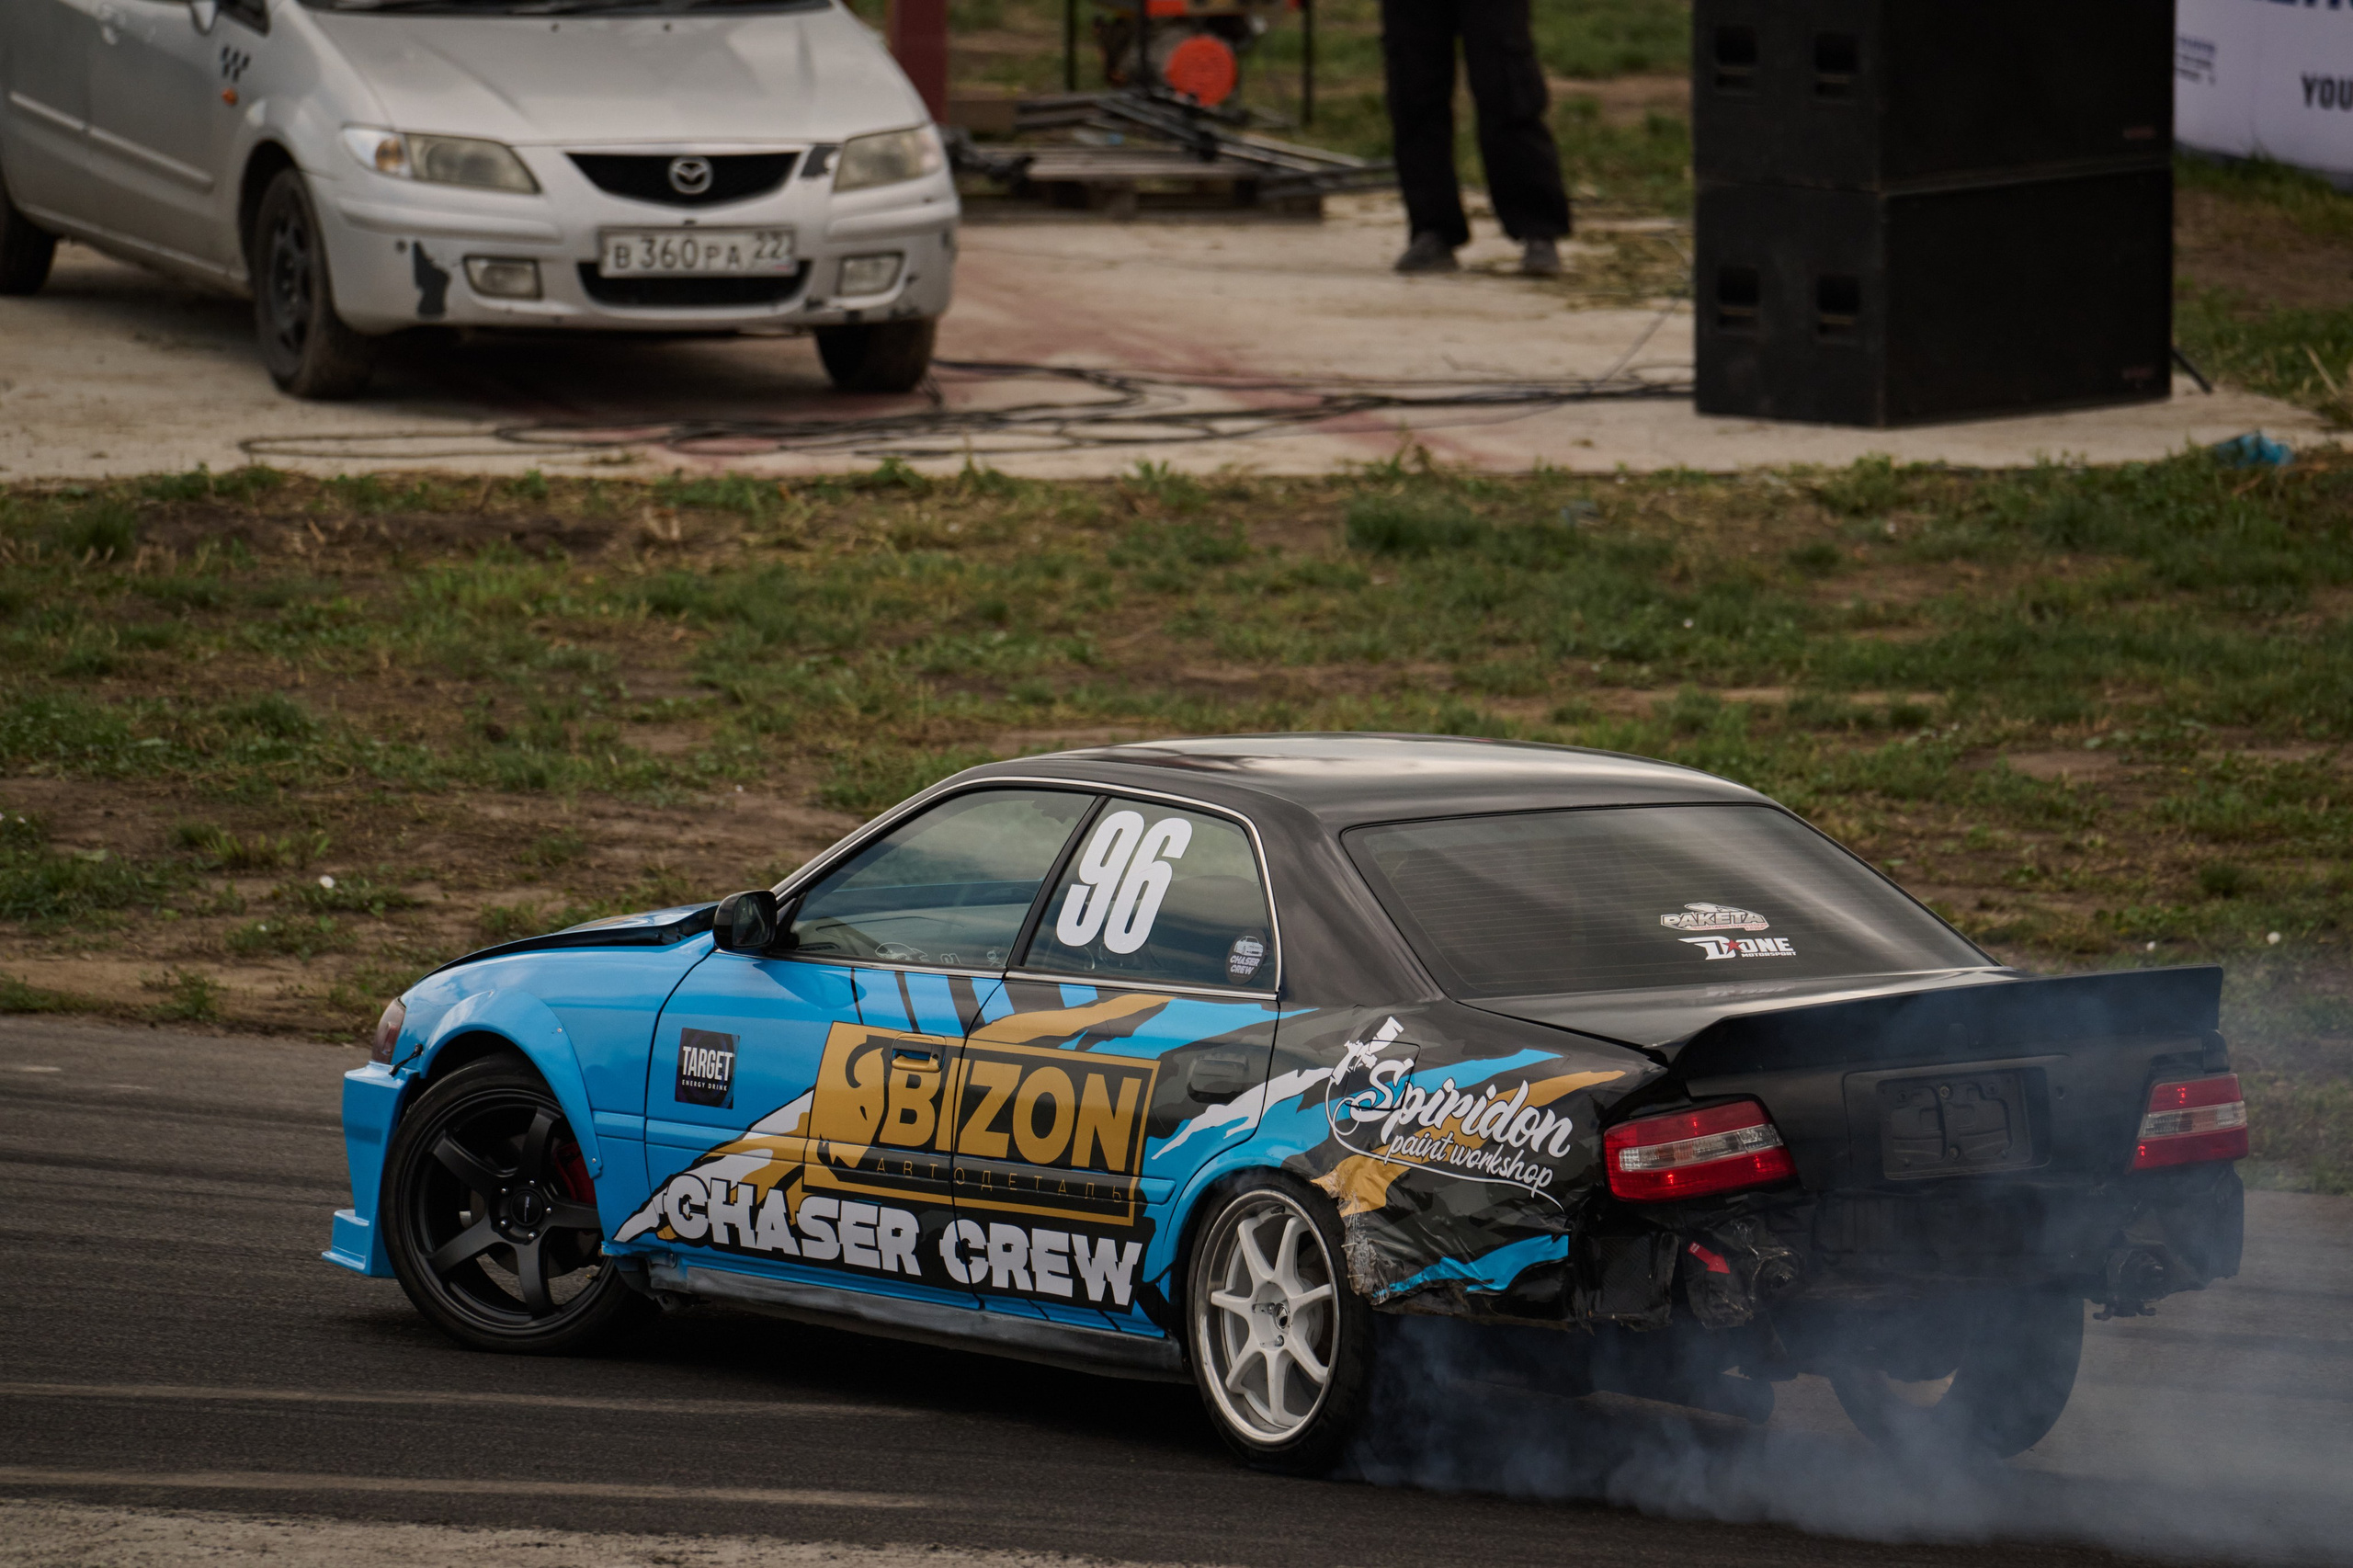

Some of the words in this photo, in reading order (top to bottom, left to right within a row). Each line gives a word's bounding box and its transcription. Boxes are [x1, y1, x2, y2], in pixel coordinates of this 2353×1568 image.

[1057, 810, 1193, 954] 96
[1230, 955, 1261, 967] CHASER
[1230, 964, 1255, 975] CREW
[681, 1079, 706, 1088] ENERGY
[707, 1083, 728, 1092] DRINK
[682, 1045, 733, 1082] TARGET
[879, 1055, 1141, 1172] BIZON
[1348, 1059, 1573, 1157] Spiridon
[1383, 1132, 1454, 1165] paint
[1449, 1144, 1554, 1199] workshop
[661, 1175, 921, 1276] CHASER
[938, 1219, 1142, 1306] CREW
